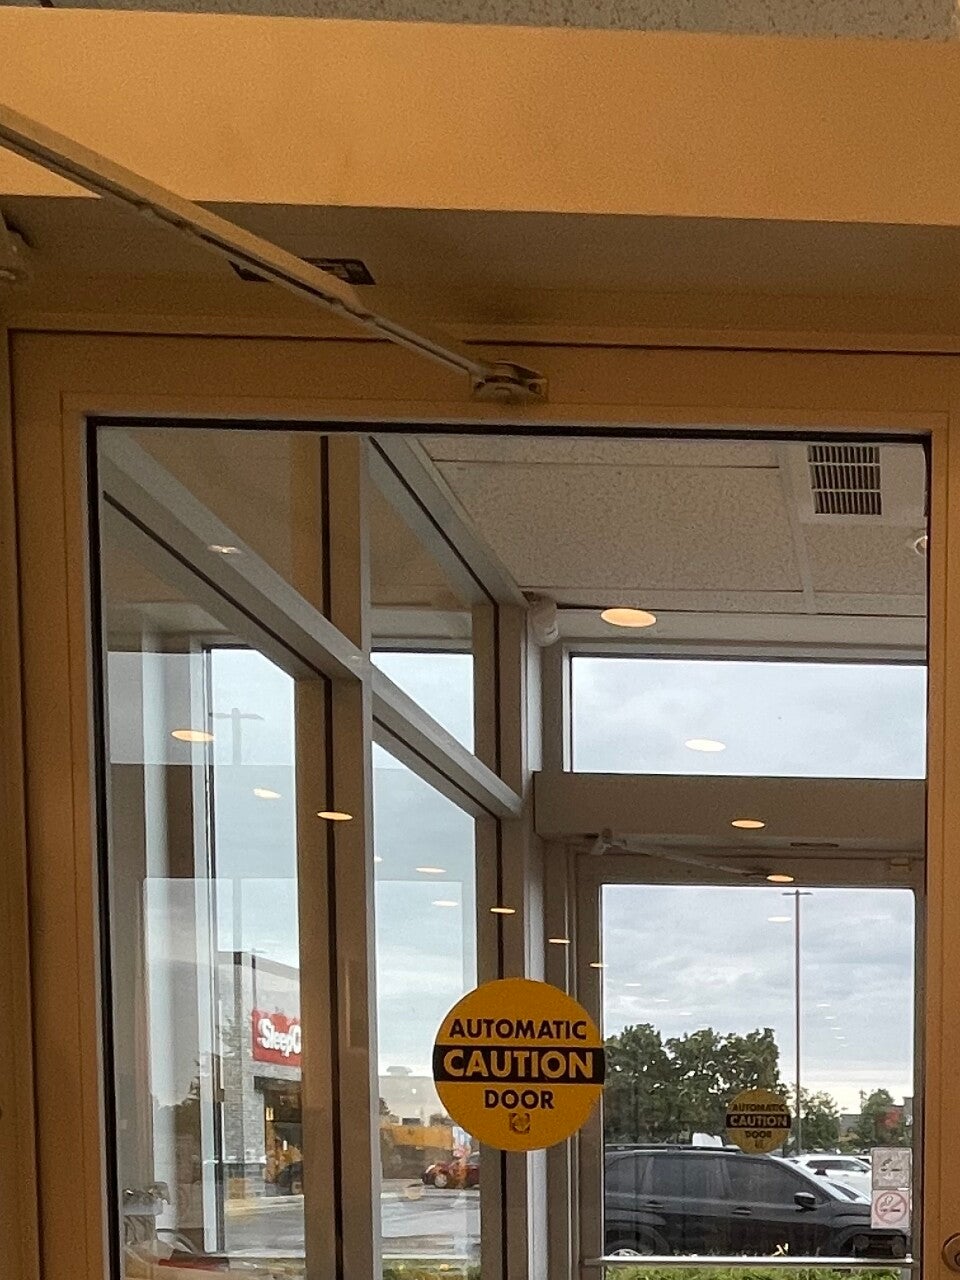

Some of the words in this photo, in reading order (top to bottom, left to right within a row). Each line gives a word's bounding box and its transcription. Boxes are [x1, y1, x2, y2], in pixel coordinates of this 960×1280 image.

[450, 1018, 587, 1040] AUTOMATIC
[443, 1049, 594, 1079] CAUTION
[484, 1089, 555, 1110] DOOR
[732, 1103, 785, 1112] AUTOMATIC
[730, 1115, 788, 1127] CAUTION
